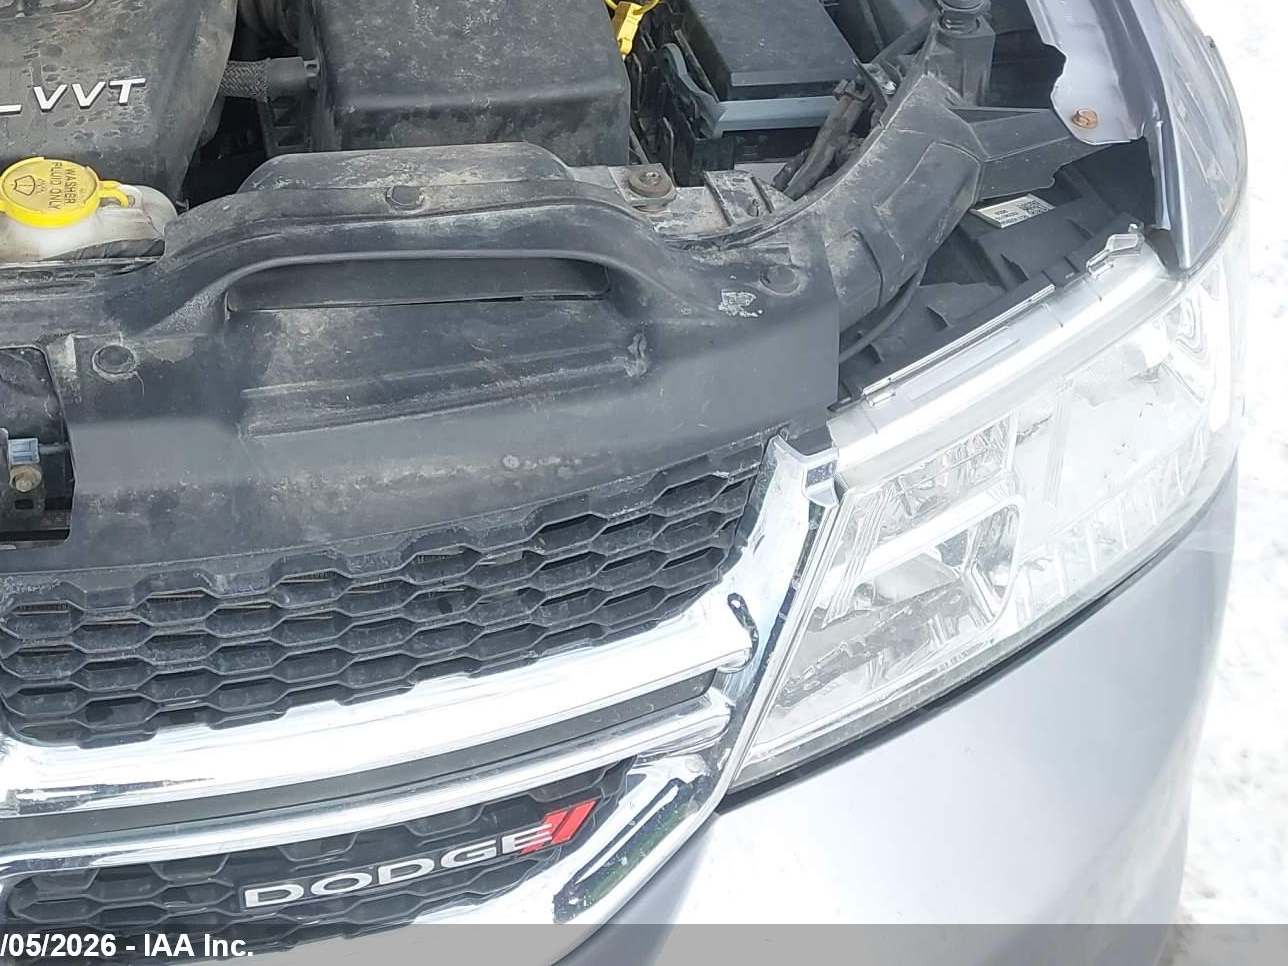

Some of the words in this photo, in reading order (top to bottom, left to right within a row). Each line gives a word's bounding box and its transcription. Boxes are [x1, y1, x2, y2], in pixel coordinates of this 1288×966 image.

[33, 77, 146, 112] VVT
[50, 162, 63, 186] FLUID
[65, 168, 77, 204] WASHER
[48, 188, 61, 210] ONLY
[244, 823, 553, 909] DODGE
